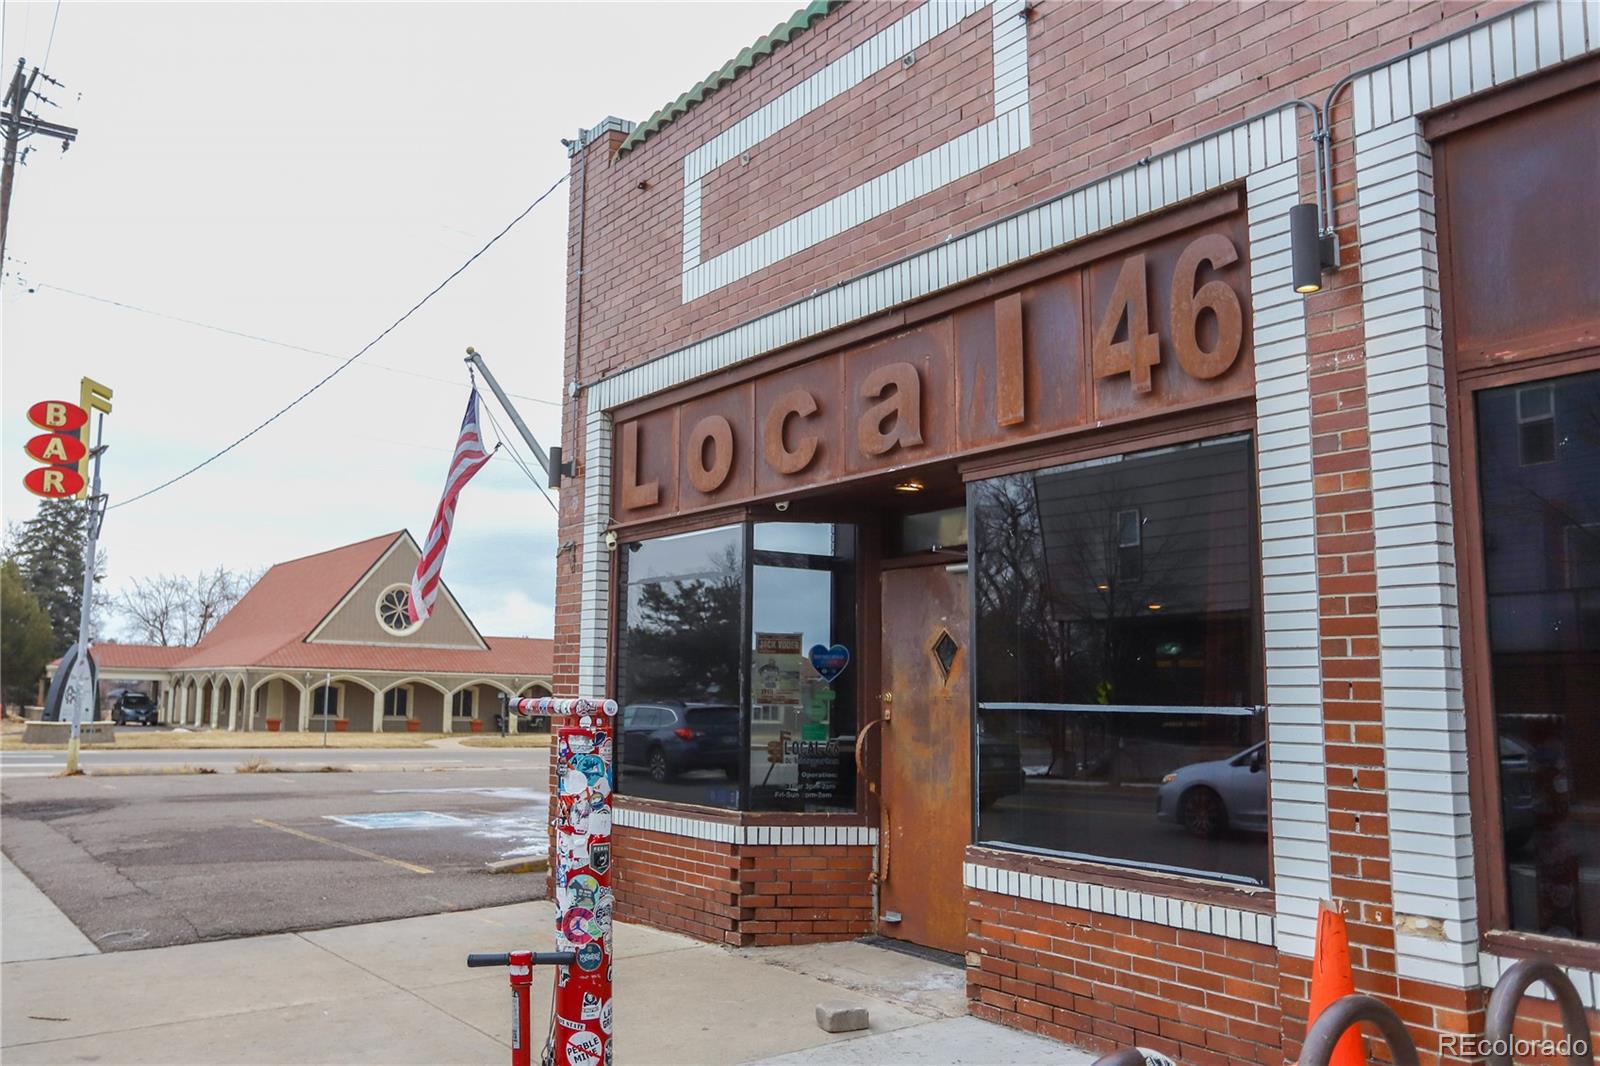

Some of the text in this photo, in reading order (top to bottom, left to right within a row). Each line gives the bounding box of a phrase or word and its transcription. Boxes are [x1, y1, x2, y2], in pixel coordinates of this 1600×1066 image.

[621, 232, 1243, 510] Local 46
[43, 402, 68, 494] BAR
[784, 740, 821, 756] LOCAL
